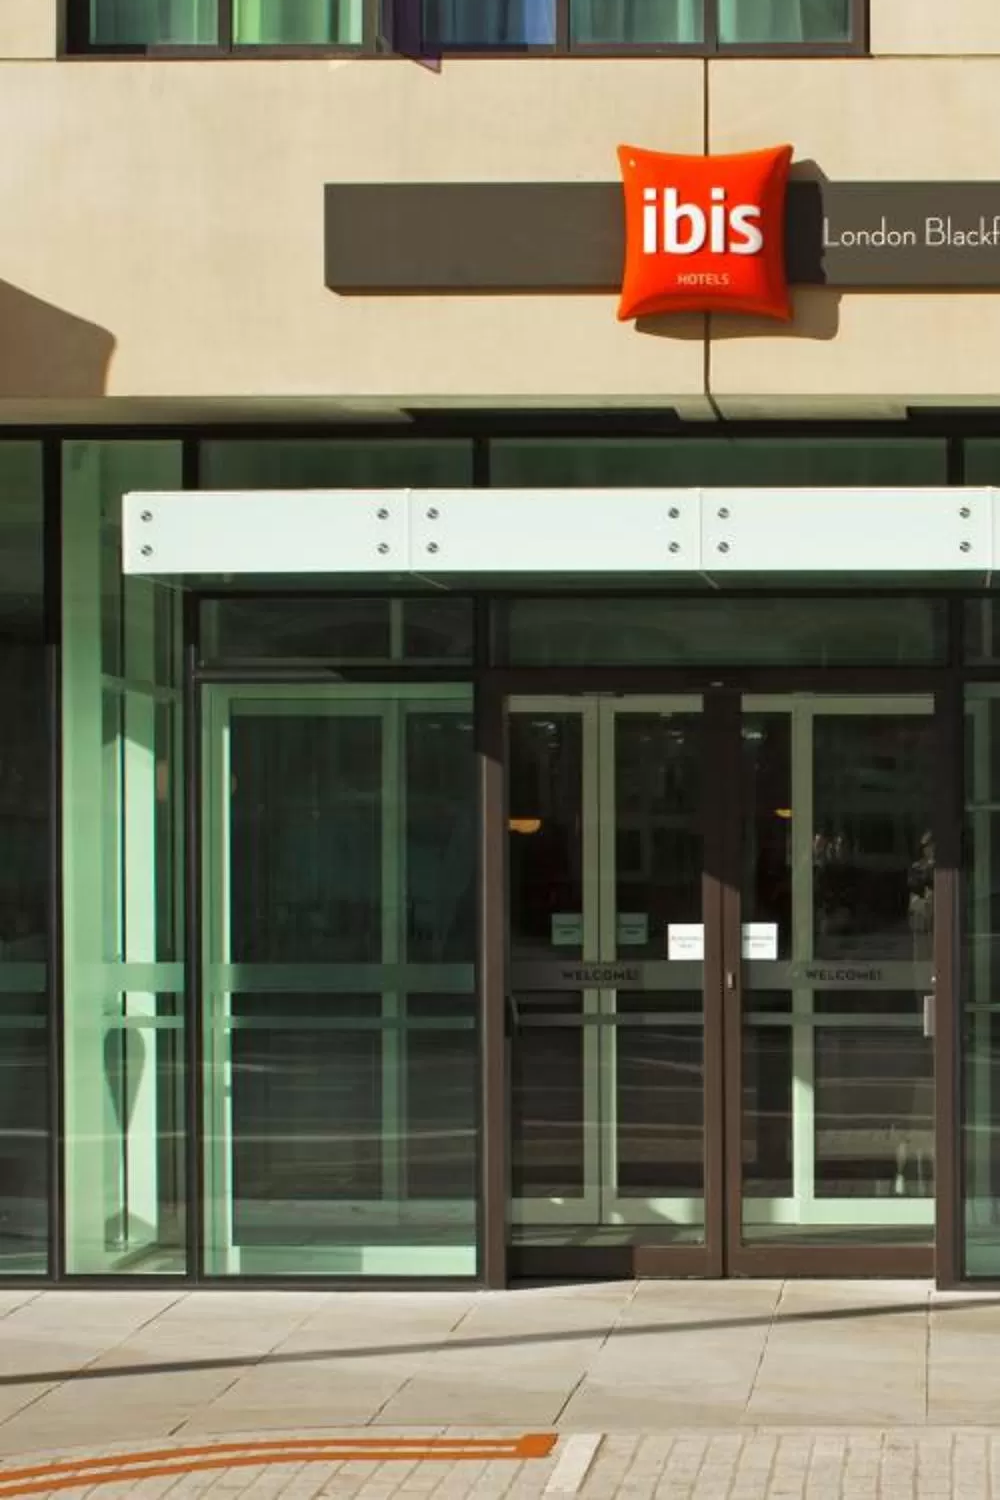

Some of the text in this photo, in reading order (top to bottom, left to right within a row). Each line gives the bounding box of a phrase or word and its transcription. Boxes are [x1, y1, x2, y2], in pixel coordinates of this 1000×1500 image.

[643, 187, 763, 254] ibis
[823, 216, 916, 246] London
[676, 272, 730, 285] HOTELS
